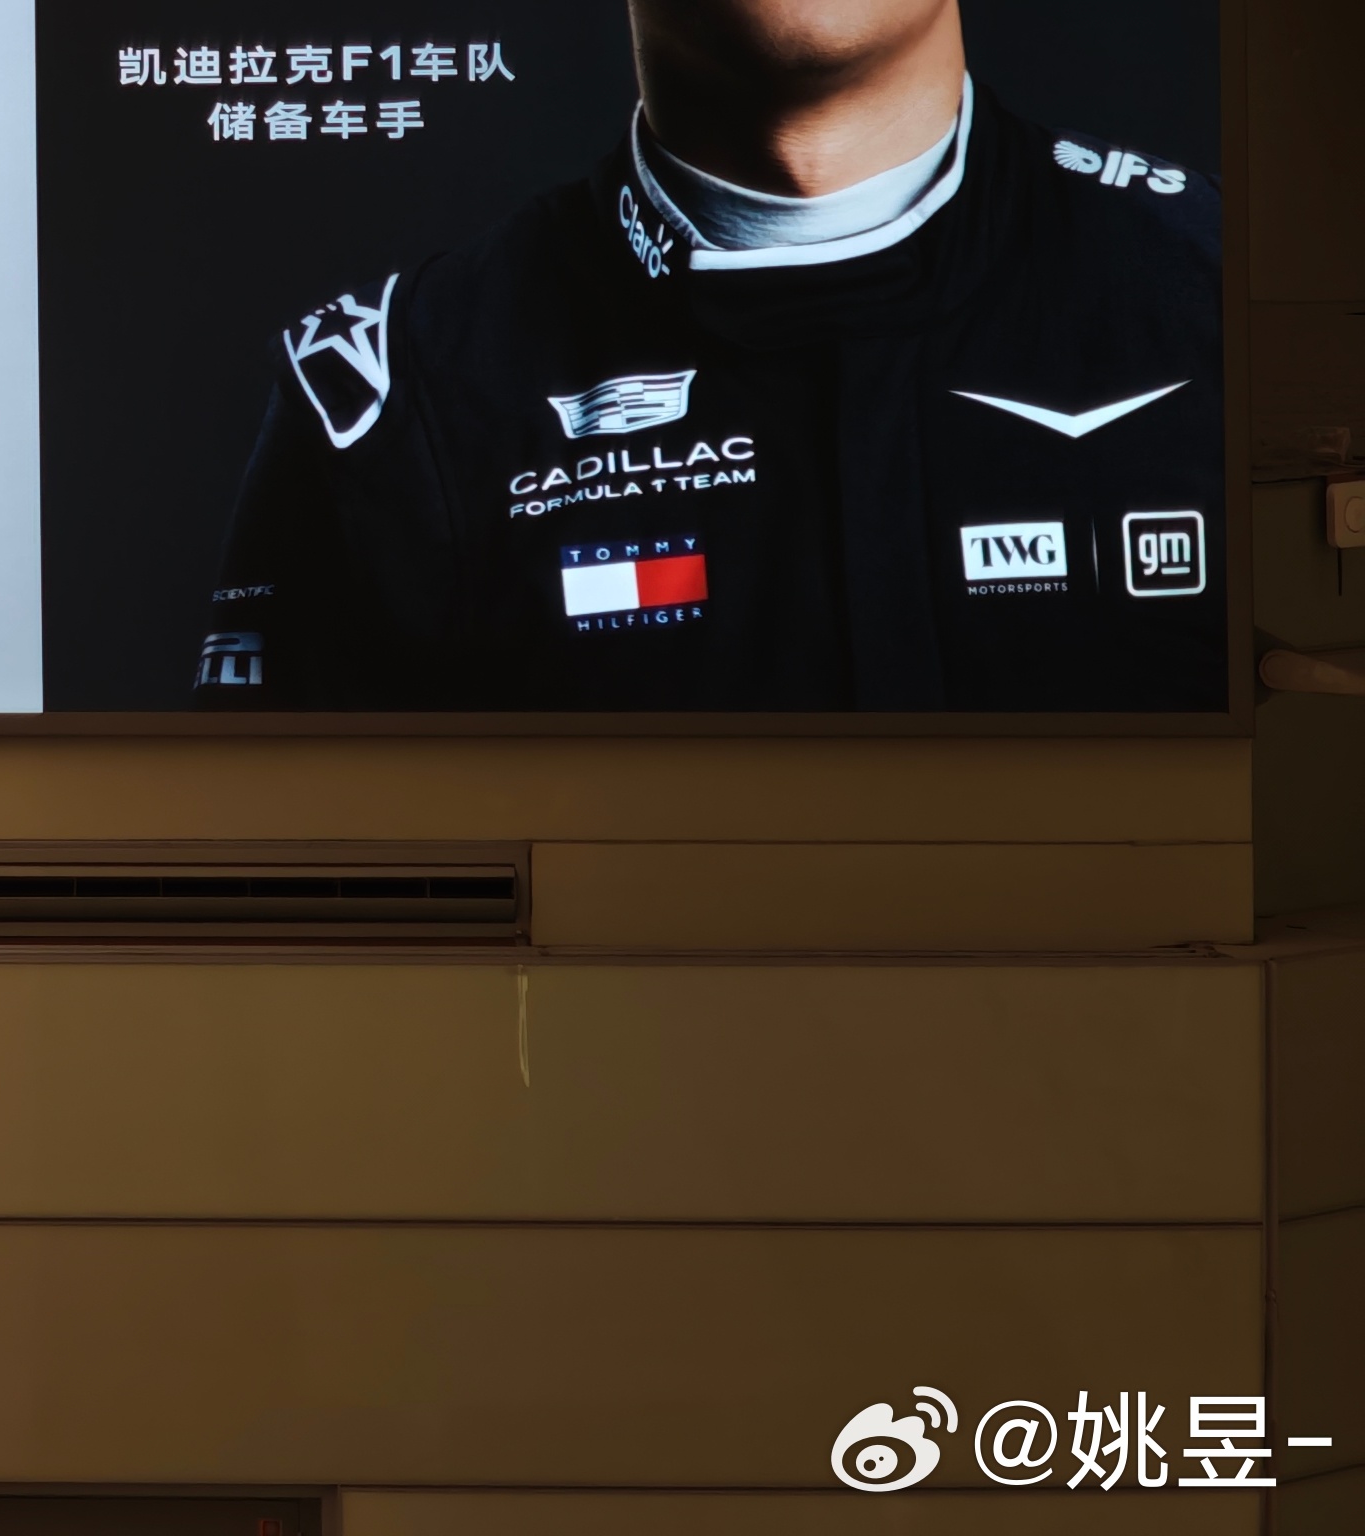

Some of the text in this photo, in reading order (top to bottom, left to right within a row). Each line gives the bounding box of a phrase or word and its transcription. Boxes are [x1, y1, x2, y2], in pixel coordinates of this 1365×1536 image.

[118, 42, 516, 86] 凯迪拉克F1车队
[207, 99, 425, 141] 储备车手
[510, 437, 755, 495] CADILLAC
[510, 482, 643, 518] FORMULA
[674, 468, 756, 491] TEAM
[570, 538, 696, 563] TOMMY
[971, 534, 1057, 568] TWG
[1138, 532, 1191, 575] gm
[212, 584, 275, 602] SCIENTIFIC
[967, 582, 1068, 596] MOTORSPORTS
[577, 607, 703, 632] HILFIGER
